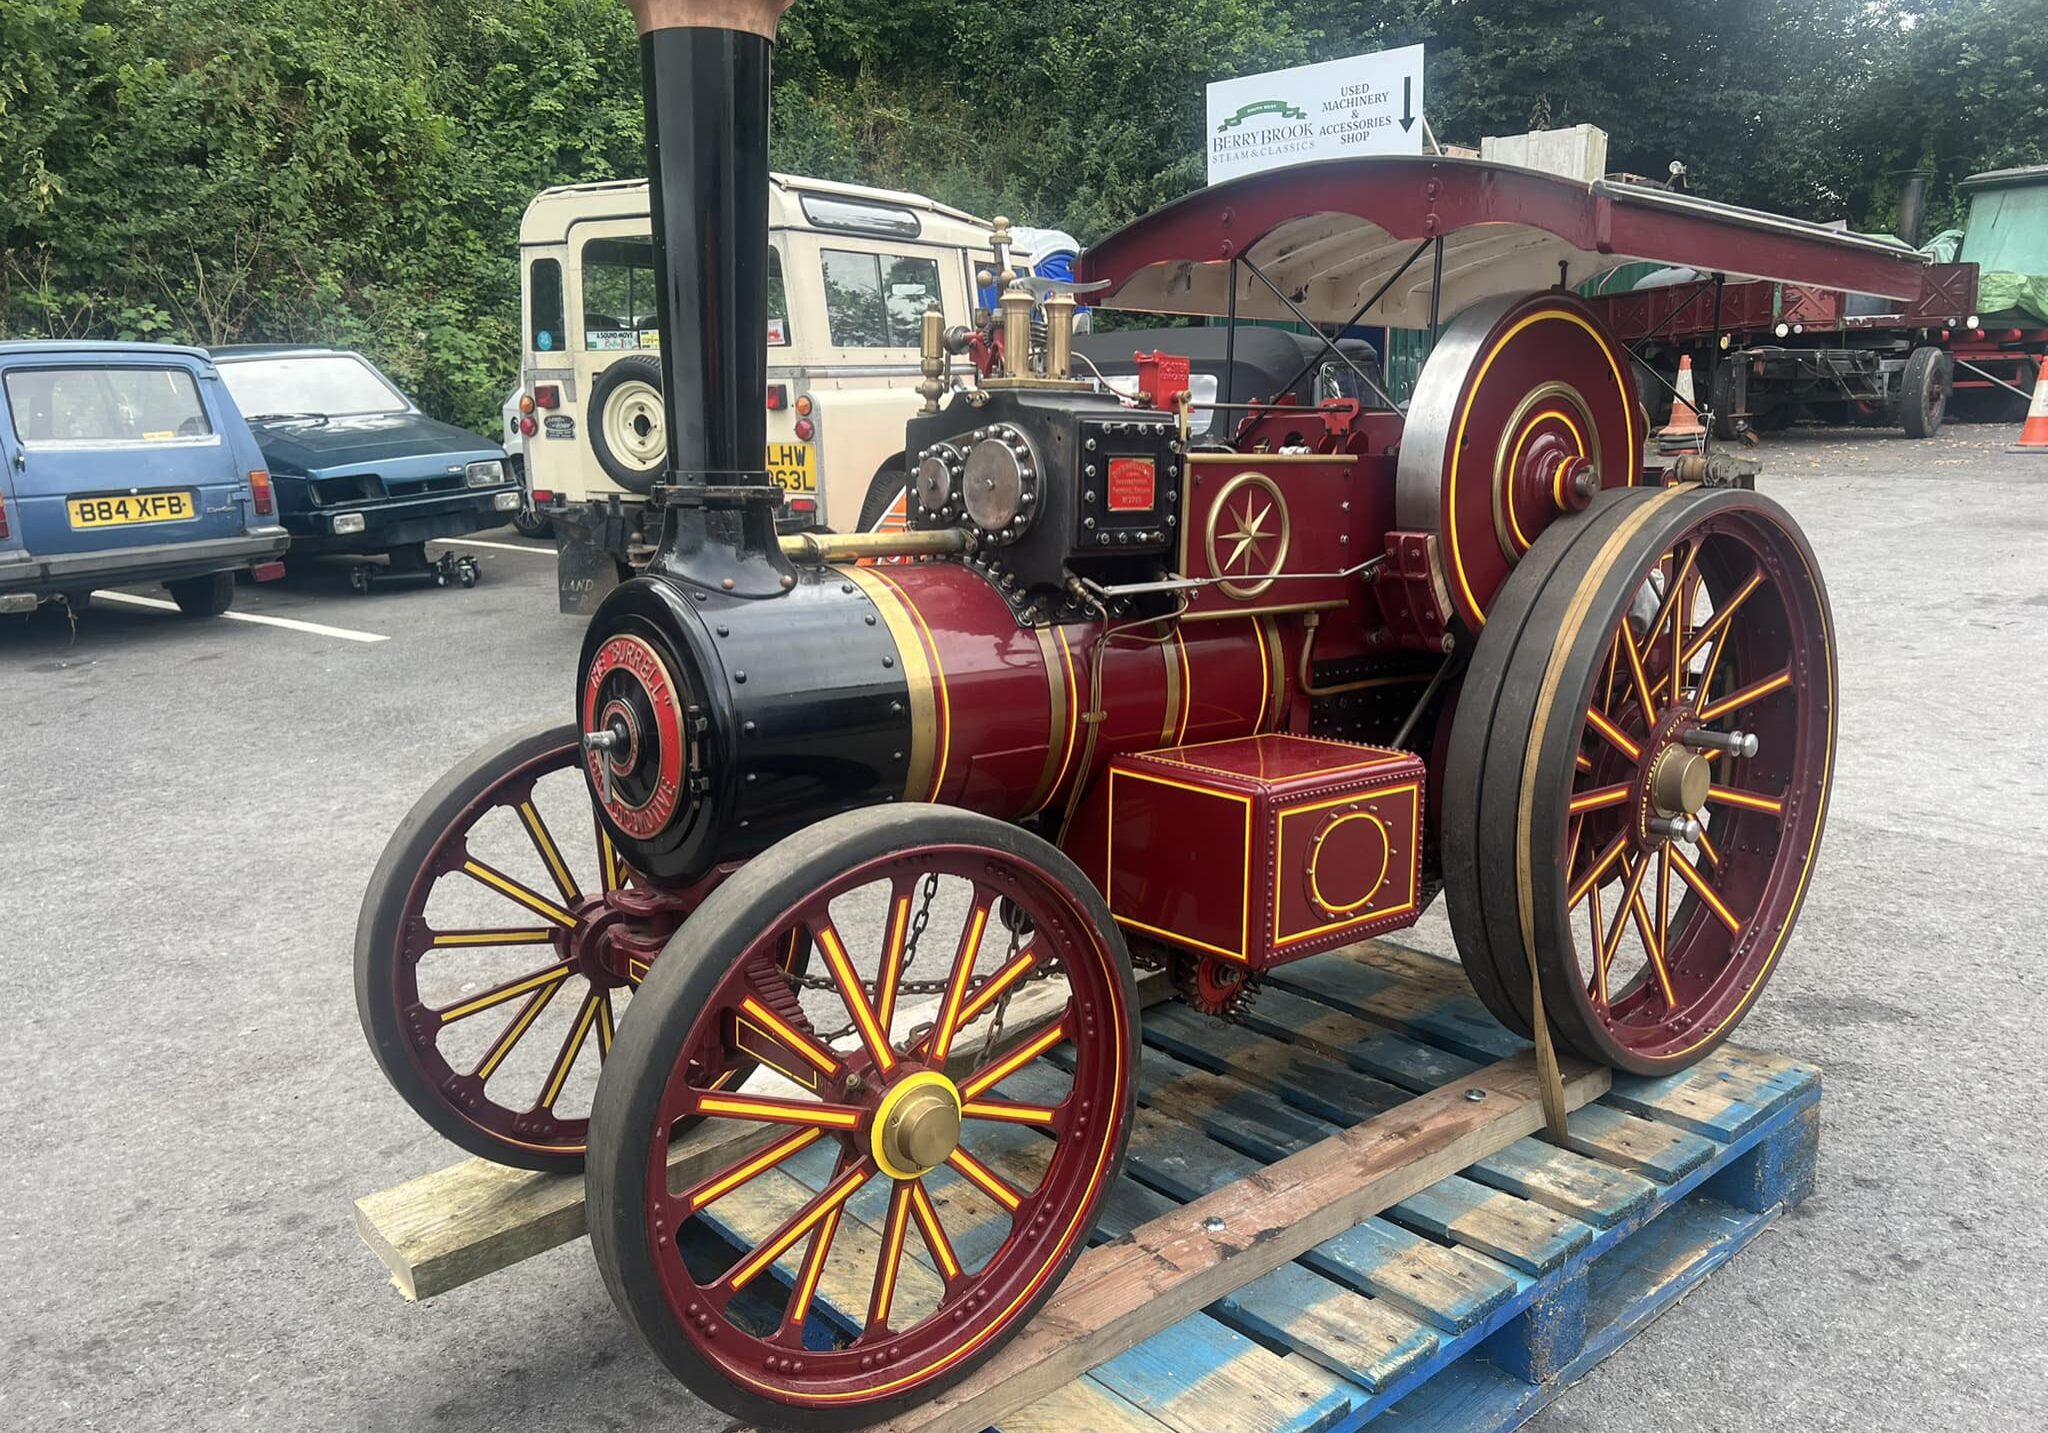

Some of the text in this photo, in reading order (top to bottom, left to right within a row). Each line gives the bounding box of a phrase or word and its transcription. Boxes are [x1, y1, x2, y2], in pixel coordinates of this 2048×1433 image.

[1341, 83, 1370, 97] USED
[1322, 92, 1389, 113] MACHINERY
[1351, 109, 1359, 119] &
[1320, 115, 1392, 136] ACCESSORIES
[1340, 131, 1370, 145] SHOP
[767, 445, 806, 467] LHW
[79, 495, 183, 523] B84 XFB
